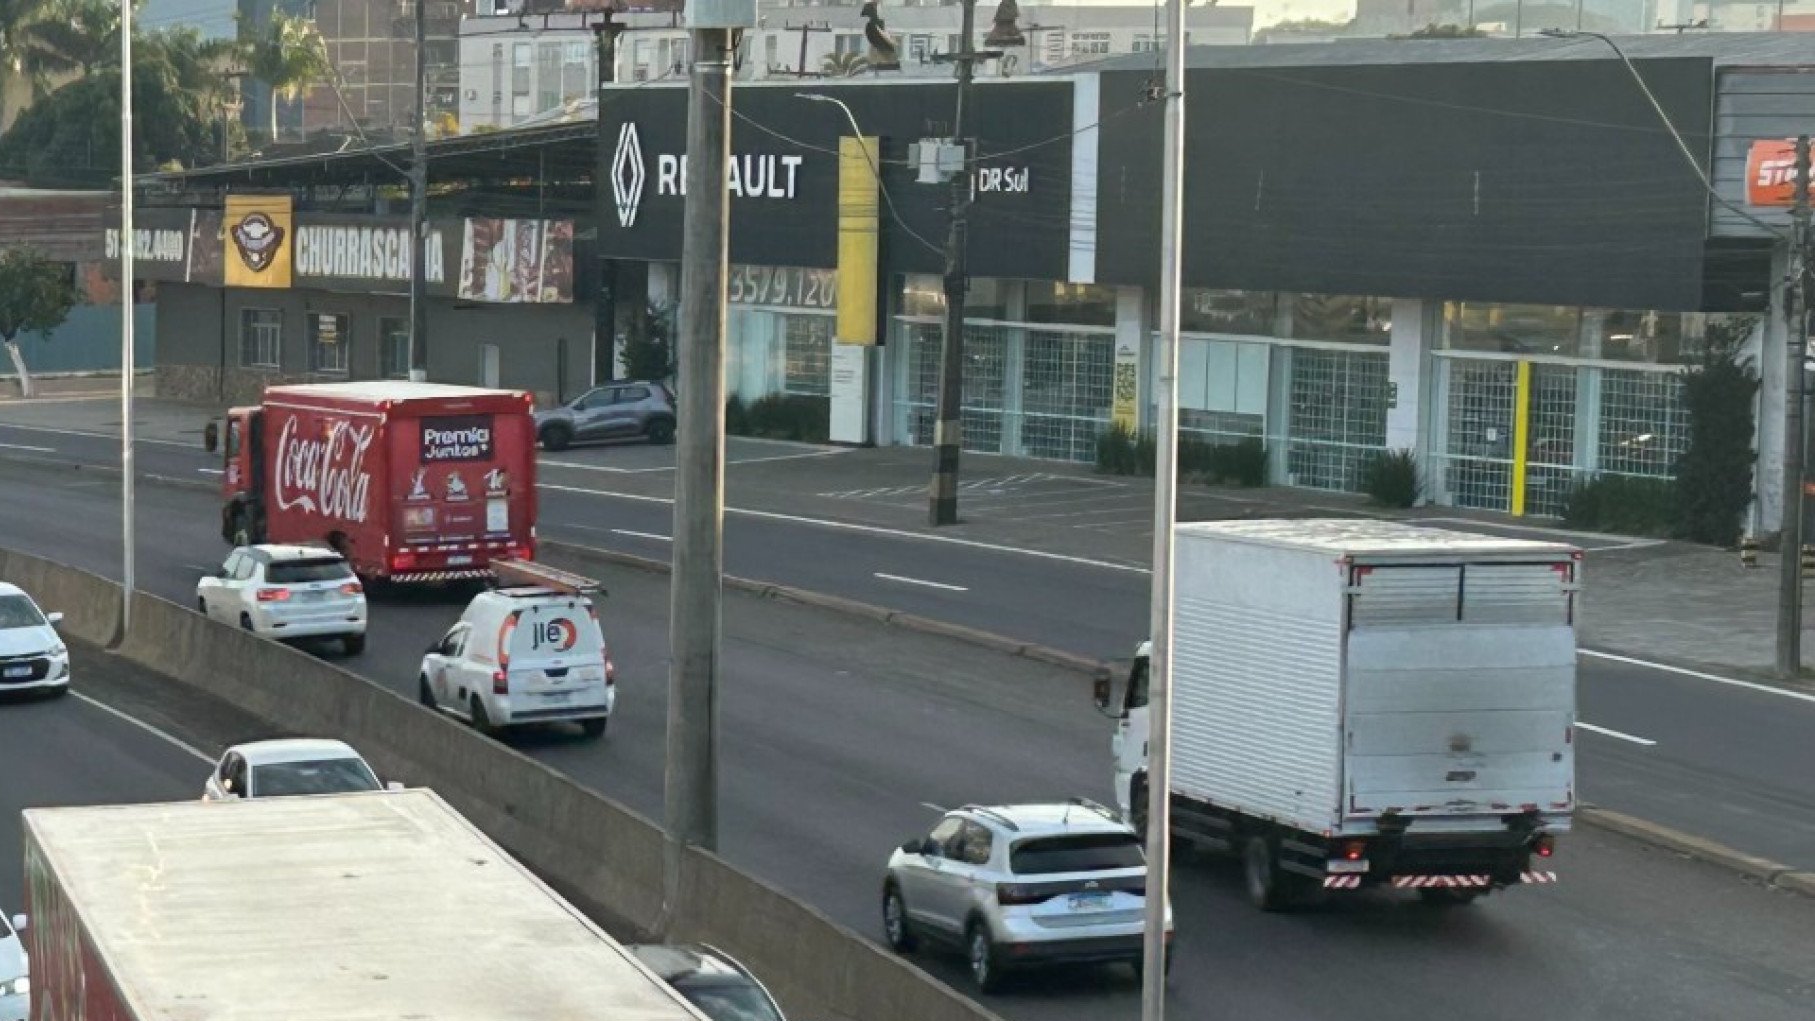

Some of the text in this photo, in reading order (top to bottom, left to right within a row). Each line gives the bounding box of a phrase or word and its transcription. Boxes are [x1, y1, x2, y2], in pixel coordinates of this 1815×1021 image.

[659, 154, 802, 198] RAULT
[979, 167, 1029, 193] DR Sul
[296, 225, 445, 283] CHURRASCAIA
[425, 427, 490, 445] Premia
